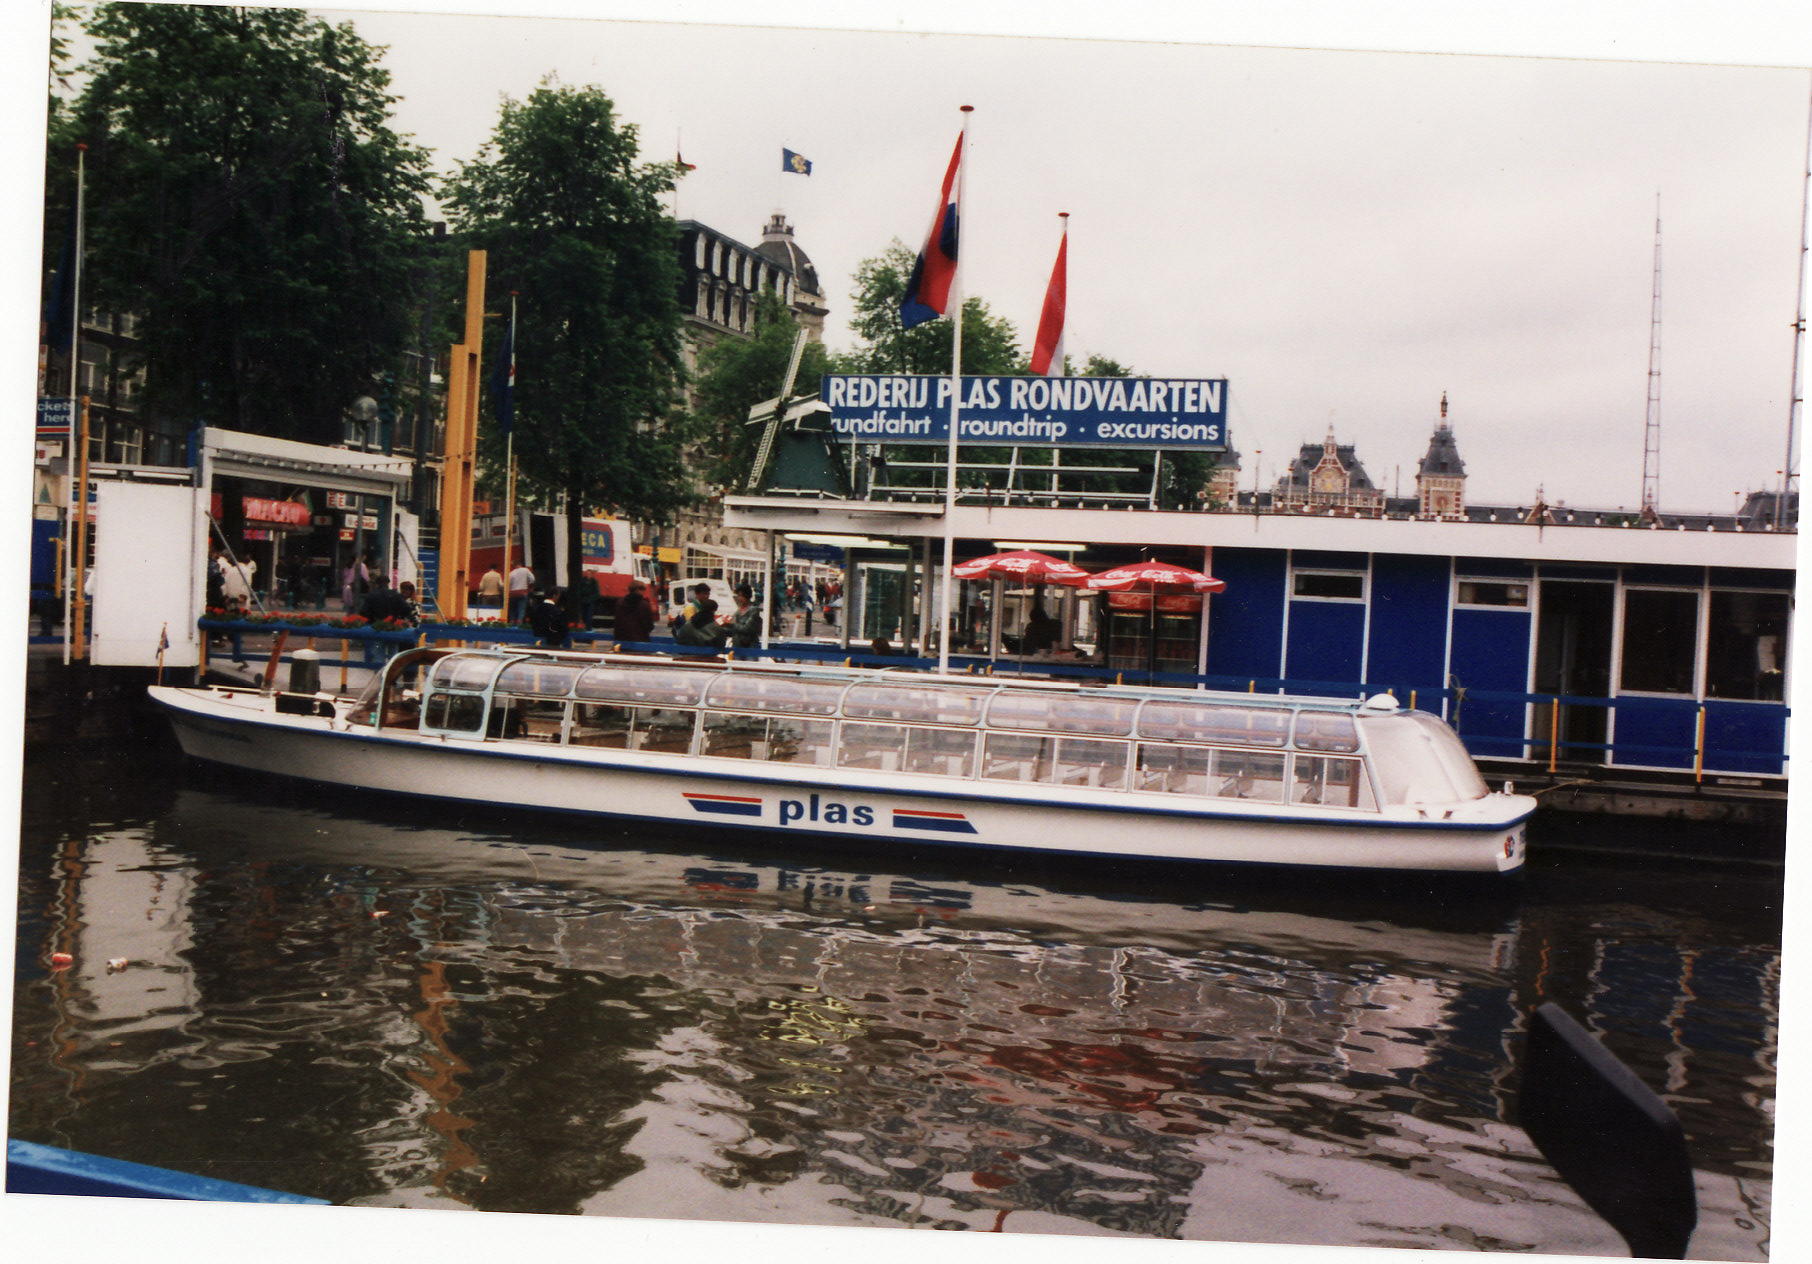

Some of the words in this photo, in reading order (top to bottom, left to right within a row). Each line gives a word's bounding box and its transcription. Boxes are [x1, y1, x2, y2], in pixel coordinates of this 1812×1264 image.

[829, 377, 929, 409] REDERIJ
[936, 378, 1002, 410] PLAS
[1010, 378, 1221, 413] RONDVAARTEN
[960, 413, 1067, 442] roundtrip
[1097, 416, 1219, 440] excursions
[779, 793, 875, 826] plas
